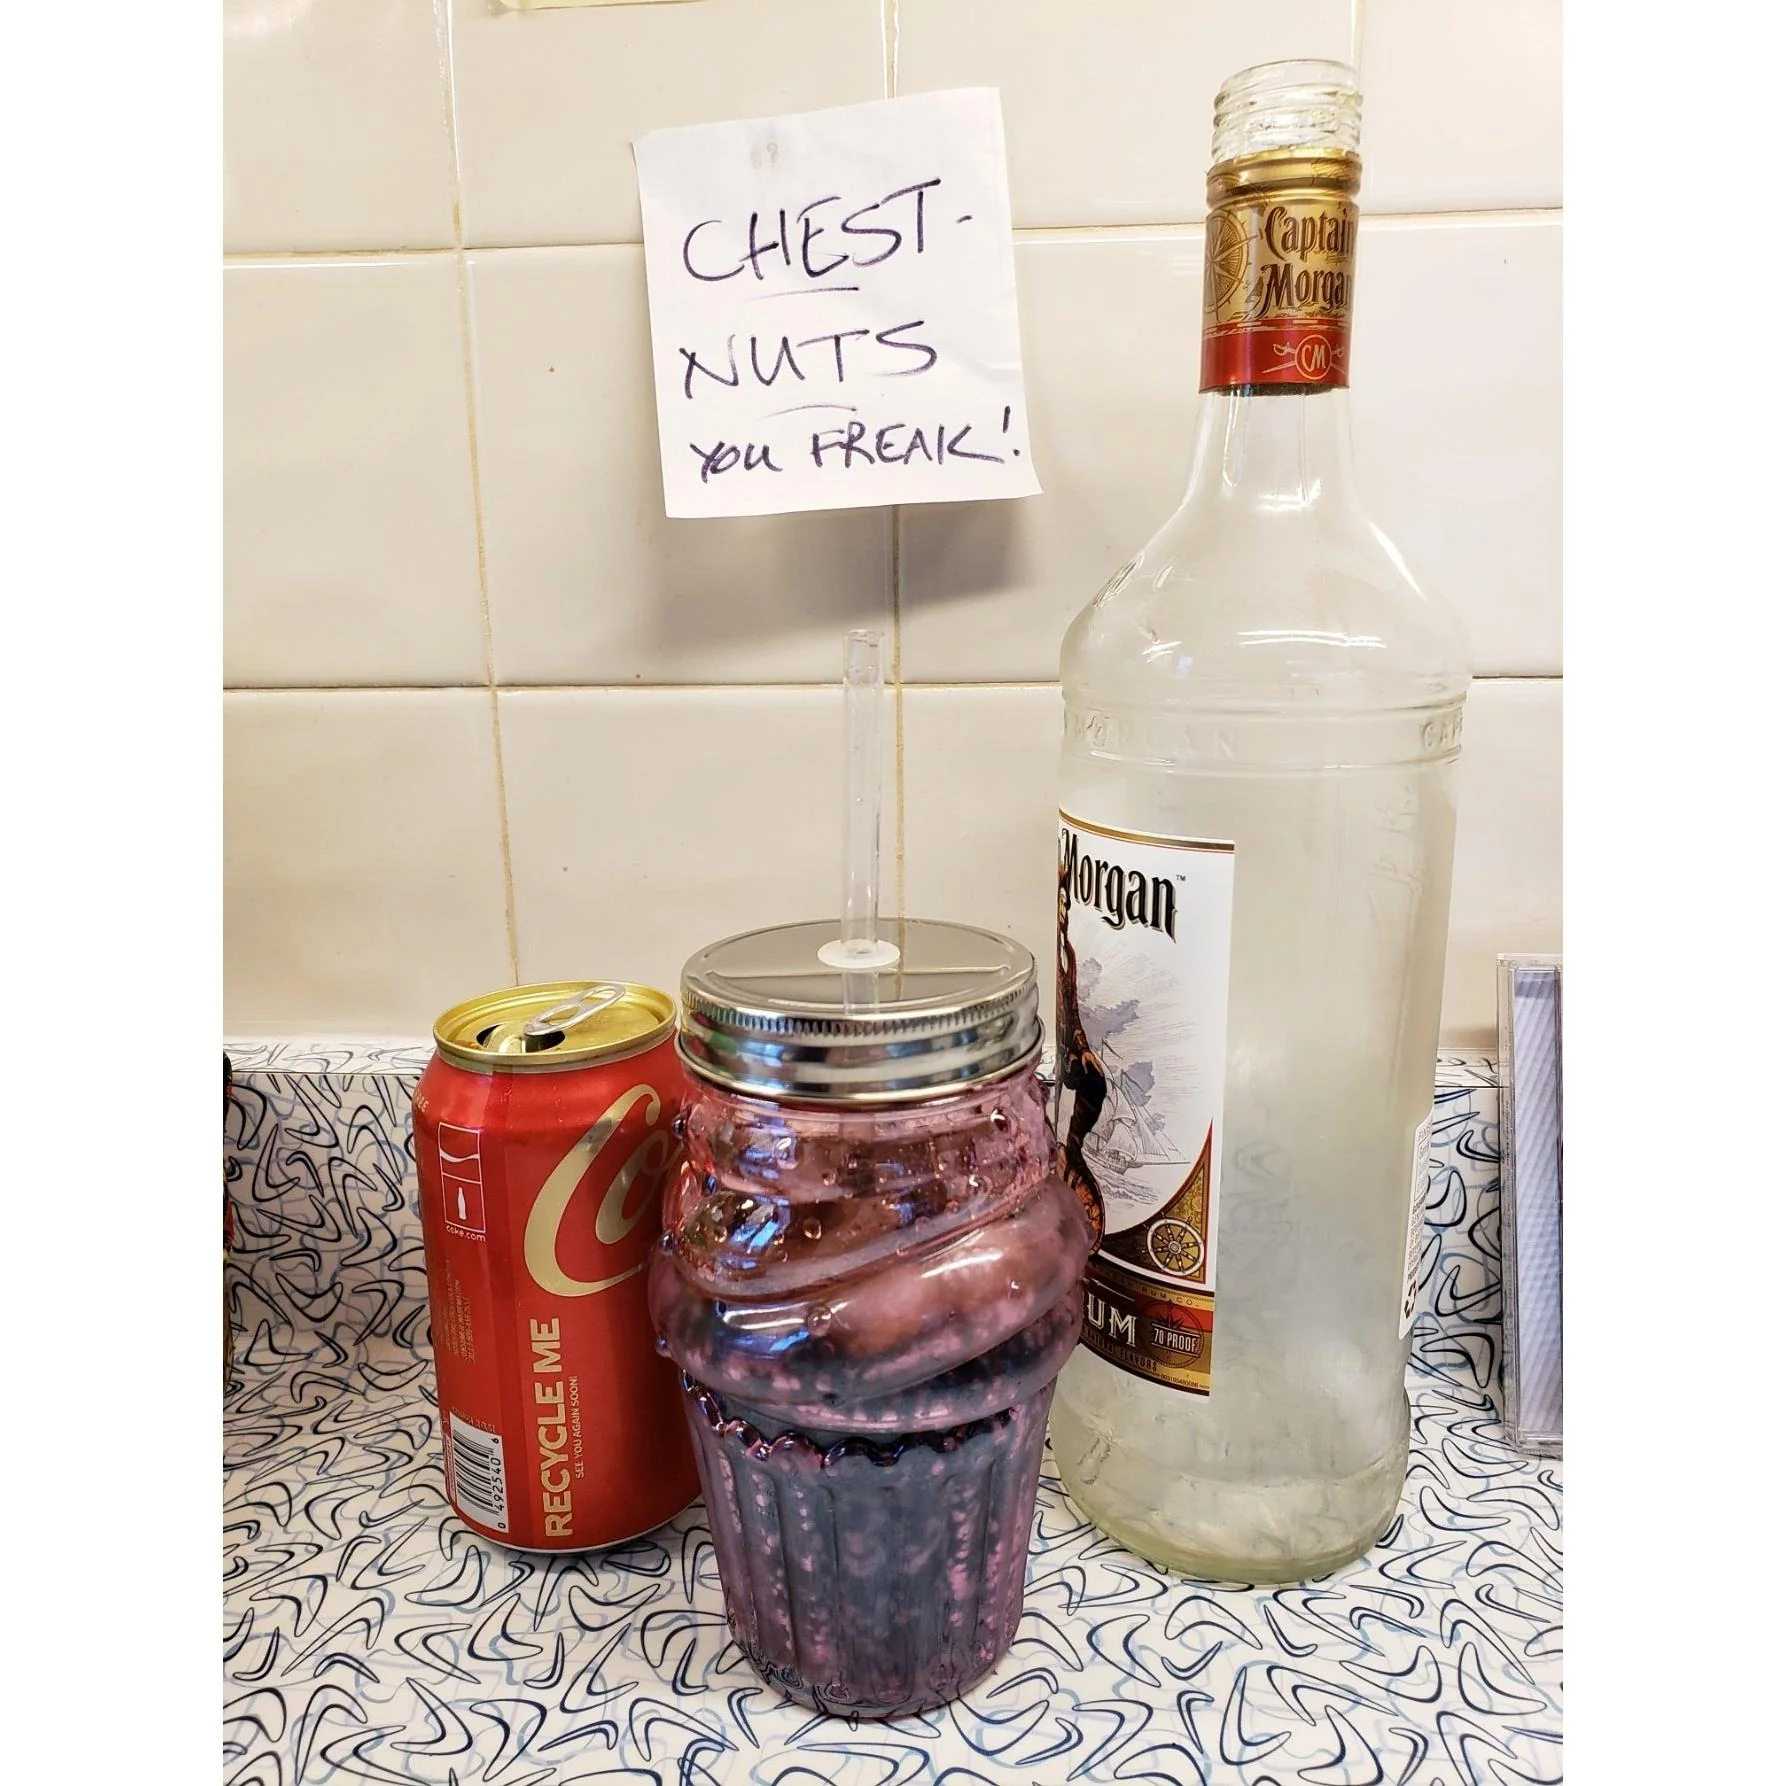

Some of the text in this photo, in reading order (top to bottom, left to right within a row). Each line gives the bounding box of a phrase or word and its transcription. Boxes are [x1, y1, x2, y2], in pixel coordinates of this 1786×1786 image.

[682, 178, 973, 282] CHEST-
[679, 320, 938, 399] NUTS
[1301, 344, 1326, 372] CM
[810, 405, 1020, 468] FREAK!
[1061, 827, 1178, 944] Morgan
[446, 1224, 486, 1242] coke.com
[1082, 1290, 1138, 1348] UM
[1153, 1327, 1198, 1353] 70 PROOF
[1120, 1344, 1158, 1372] FLAVORS
[529, 1317, 574, 1537] RECYCLE ME
[568, 1375, 585, 1479] SEE YOU AGAIN SOON!
[490, 1457, 505, 1512] 492540
[497, 1522, 506, 1530] 0
